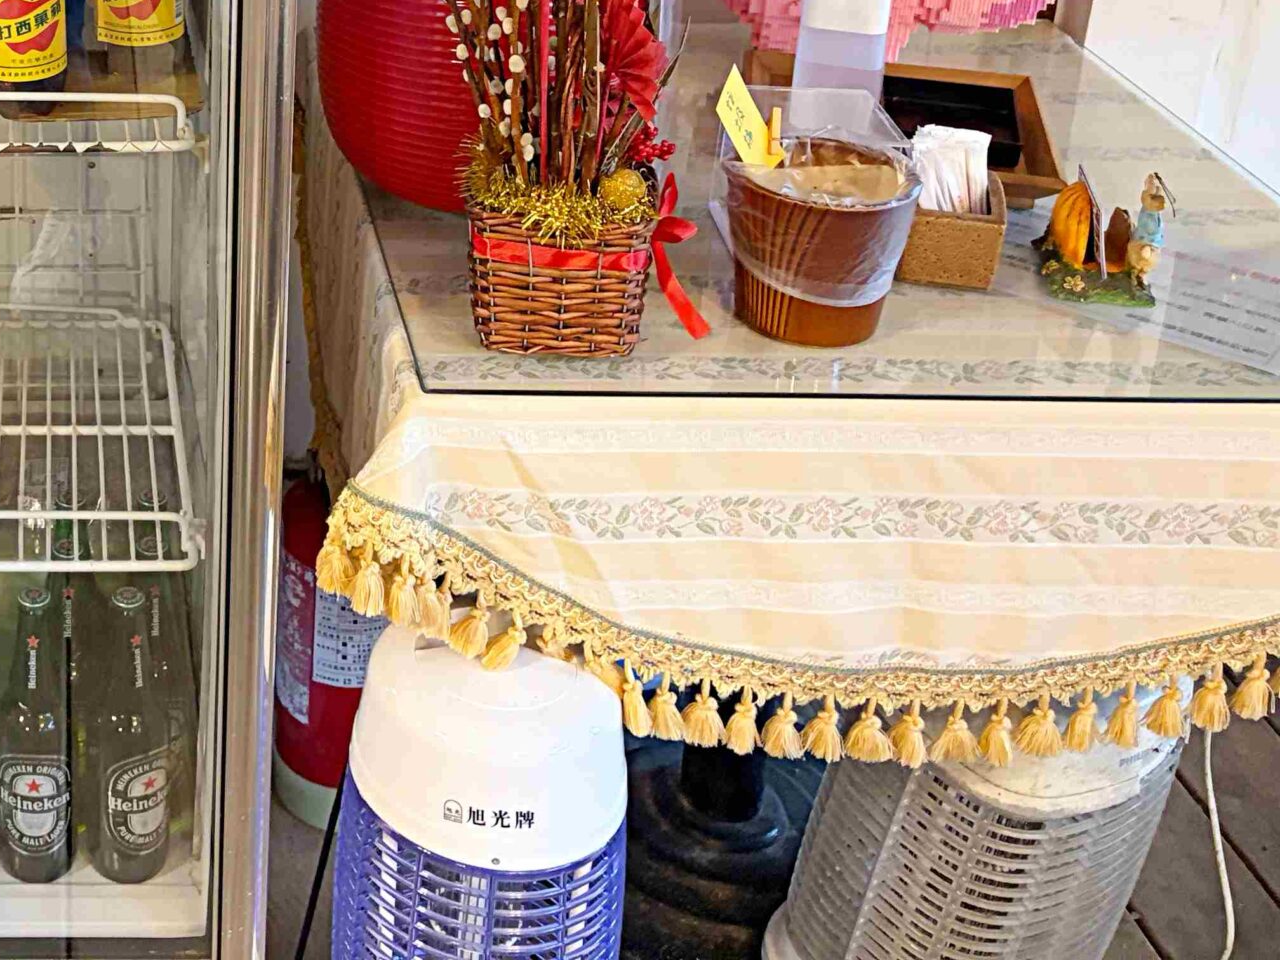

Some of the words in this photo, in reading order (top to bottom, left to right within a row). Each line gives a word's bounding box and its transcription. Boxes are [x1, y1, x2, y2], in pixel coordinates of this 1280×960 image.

[1, 787, 70, 811] Heineken
[466, 806, 535, 829] 旭光牌
